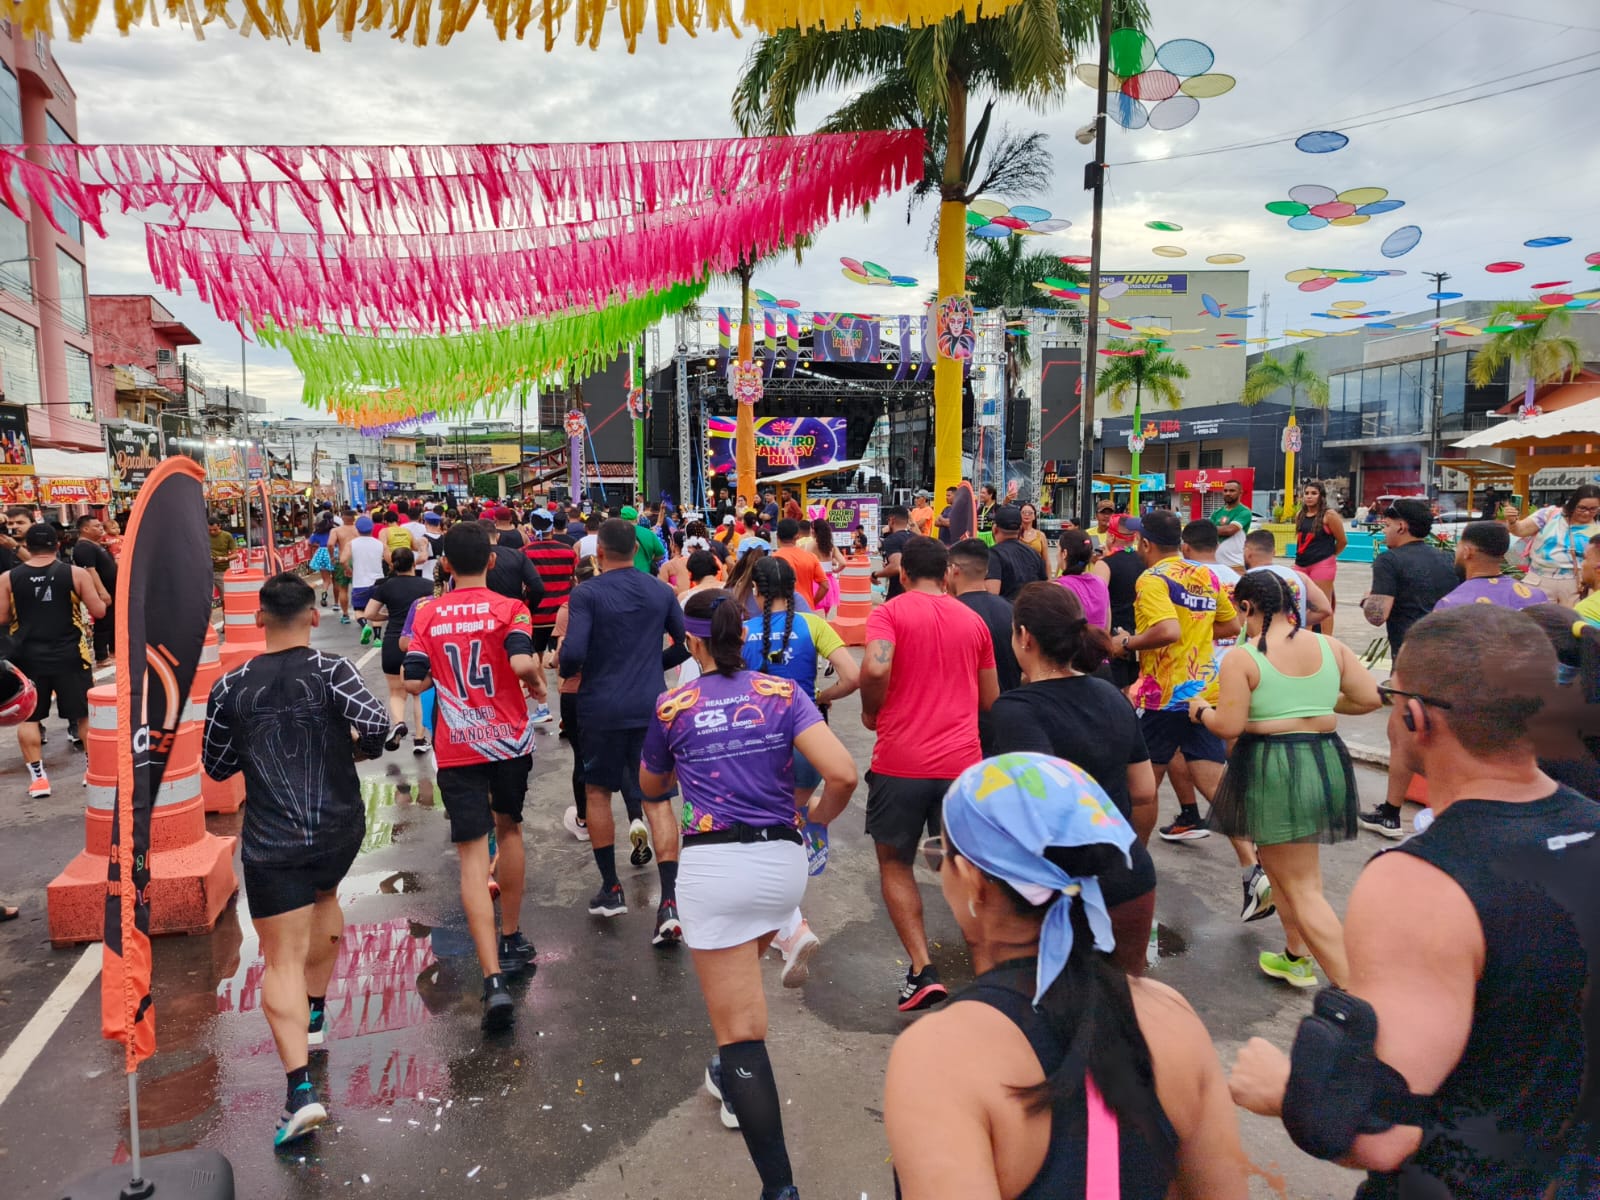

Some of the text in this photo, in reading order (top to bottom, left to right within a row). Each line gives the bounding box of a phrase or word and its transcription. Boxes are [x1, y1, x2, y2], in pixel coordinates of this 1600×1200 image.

[1123, 274, 1168, 284] UNIP
[768, 456, 799, 466] RUN
[51, 485, 89, 495] AMSTEL
[431, 623, 452, 637] DOM
[456, 620, 484, 633] PEDRO
[444, 640, 495, 700] 14
[462, 706, 496, 721] PEDRO
[450, 723, 515, 744] HANDEBOL
